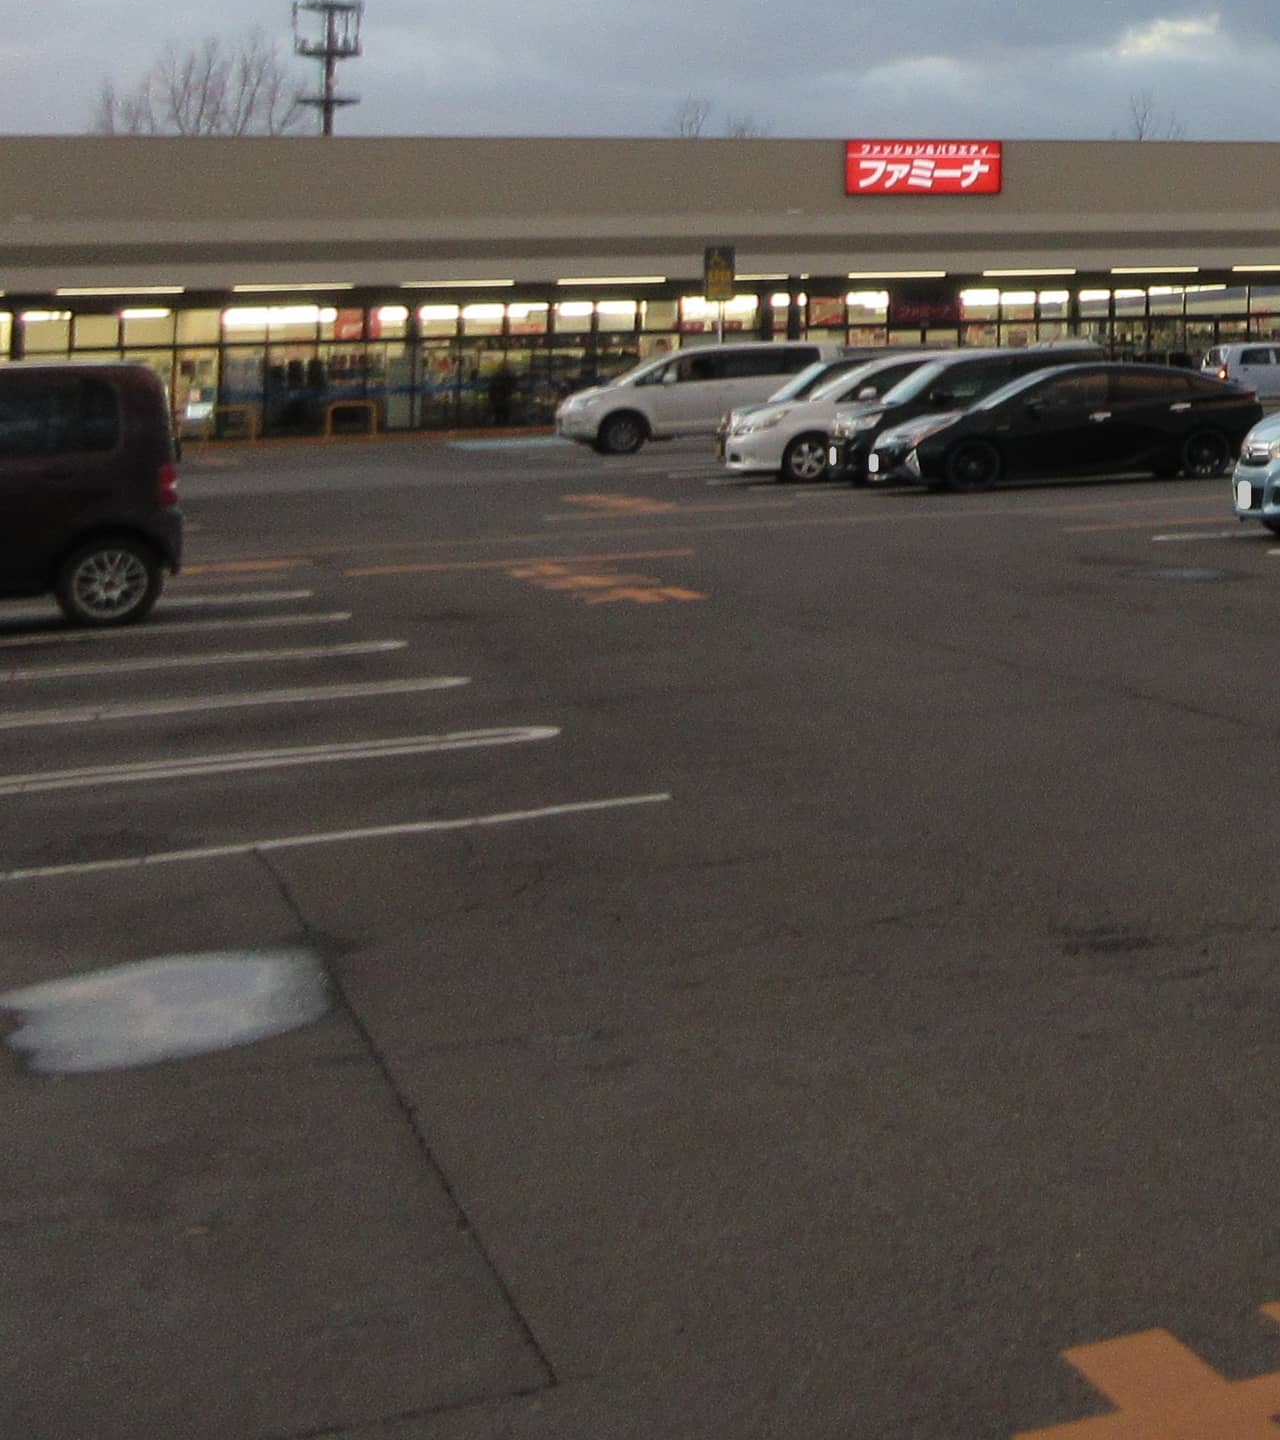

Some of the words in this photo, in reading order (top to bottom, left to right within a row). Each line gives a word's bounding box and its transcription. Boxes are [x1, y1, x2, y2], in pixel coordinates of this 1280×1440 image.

[859, 159, 990, 189] ファミーナ
